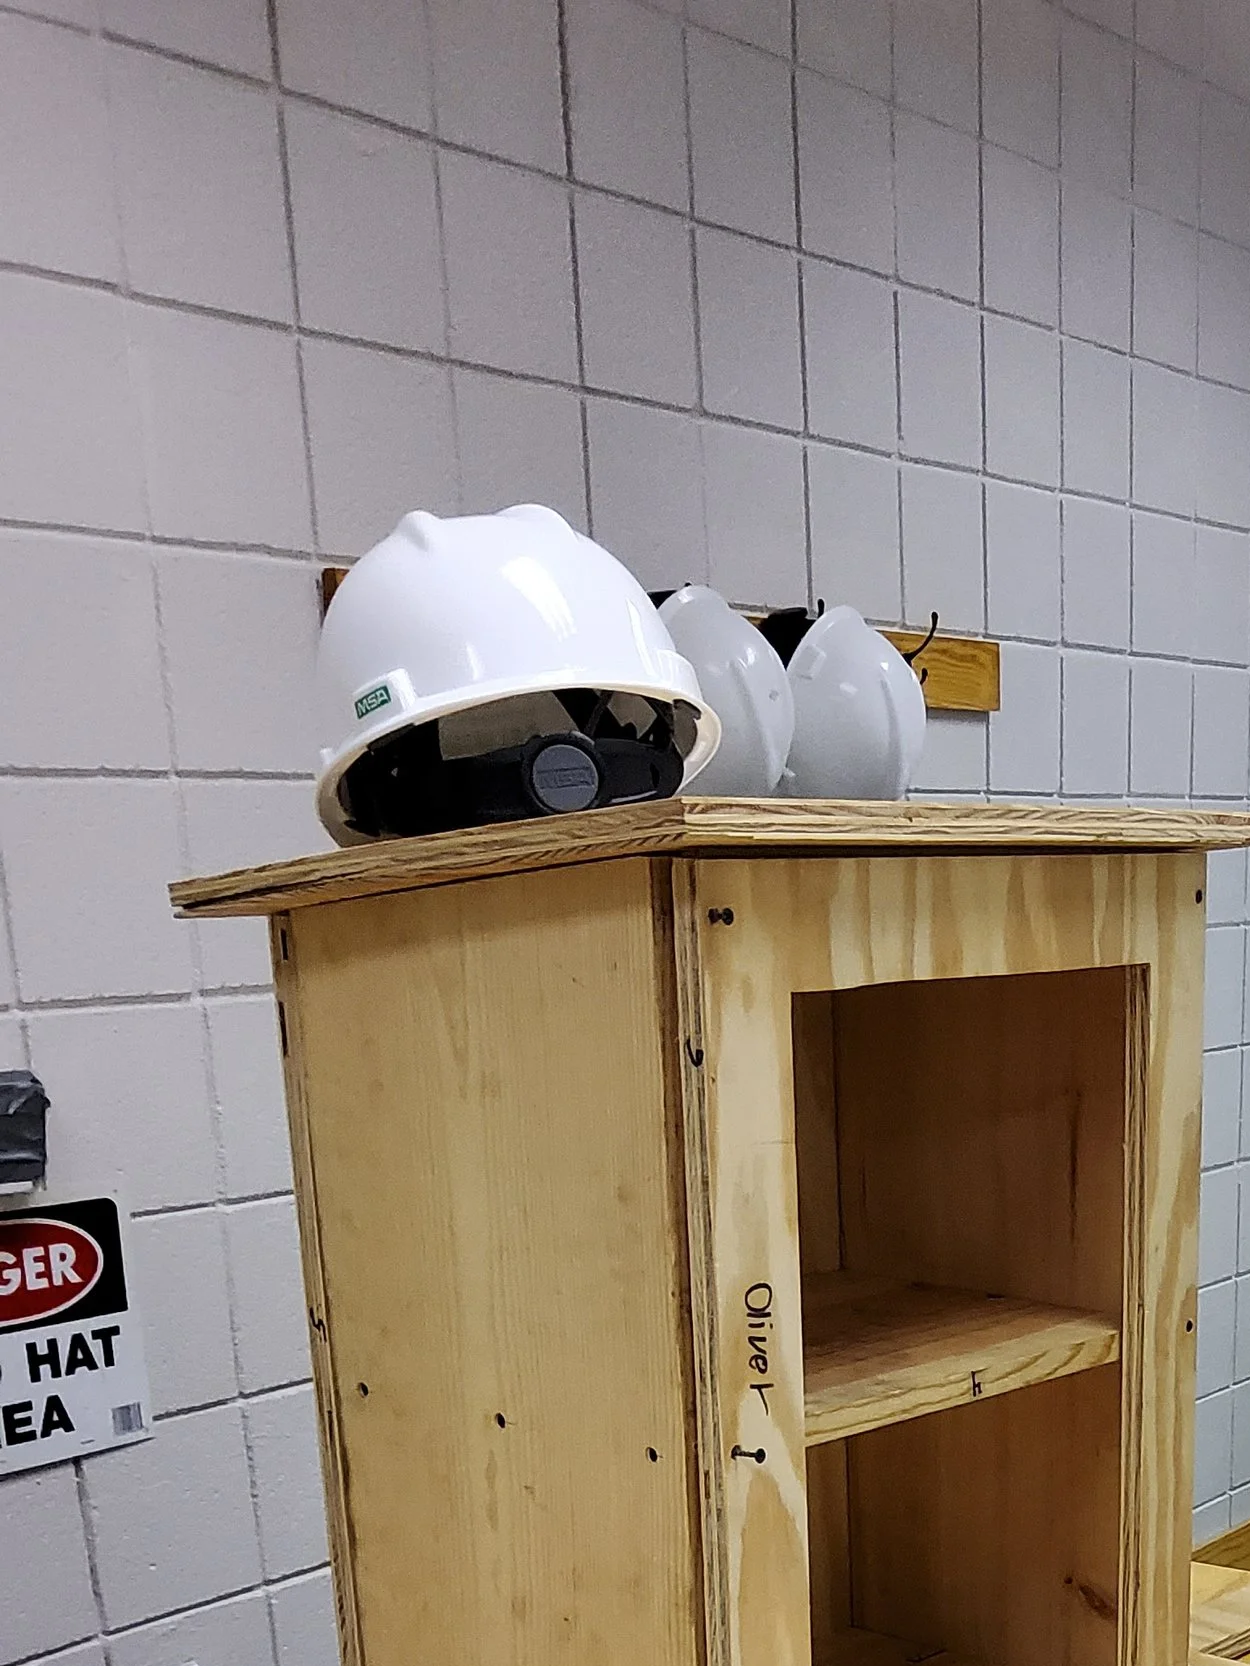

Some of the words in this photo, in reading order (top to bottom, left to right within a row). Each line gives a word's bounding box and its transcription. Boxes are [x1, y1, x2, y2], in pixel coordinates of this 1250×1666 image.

[357, 685, 389, 717] MSA
[25, 1325, 121, 1383] HAT
[745, 1282, 774, 1416] Oliver
